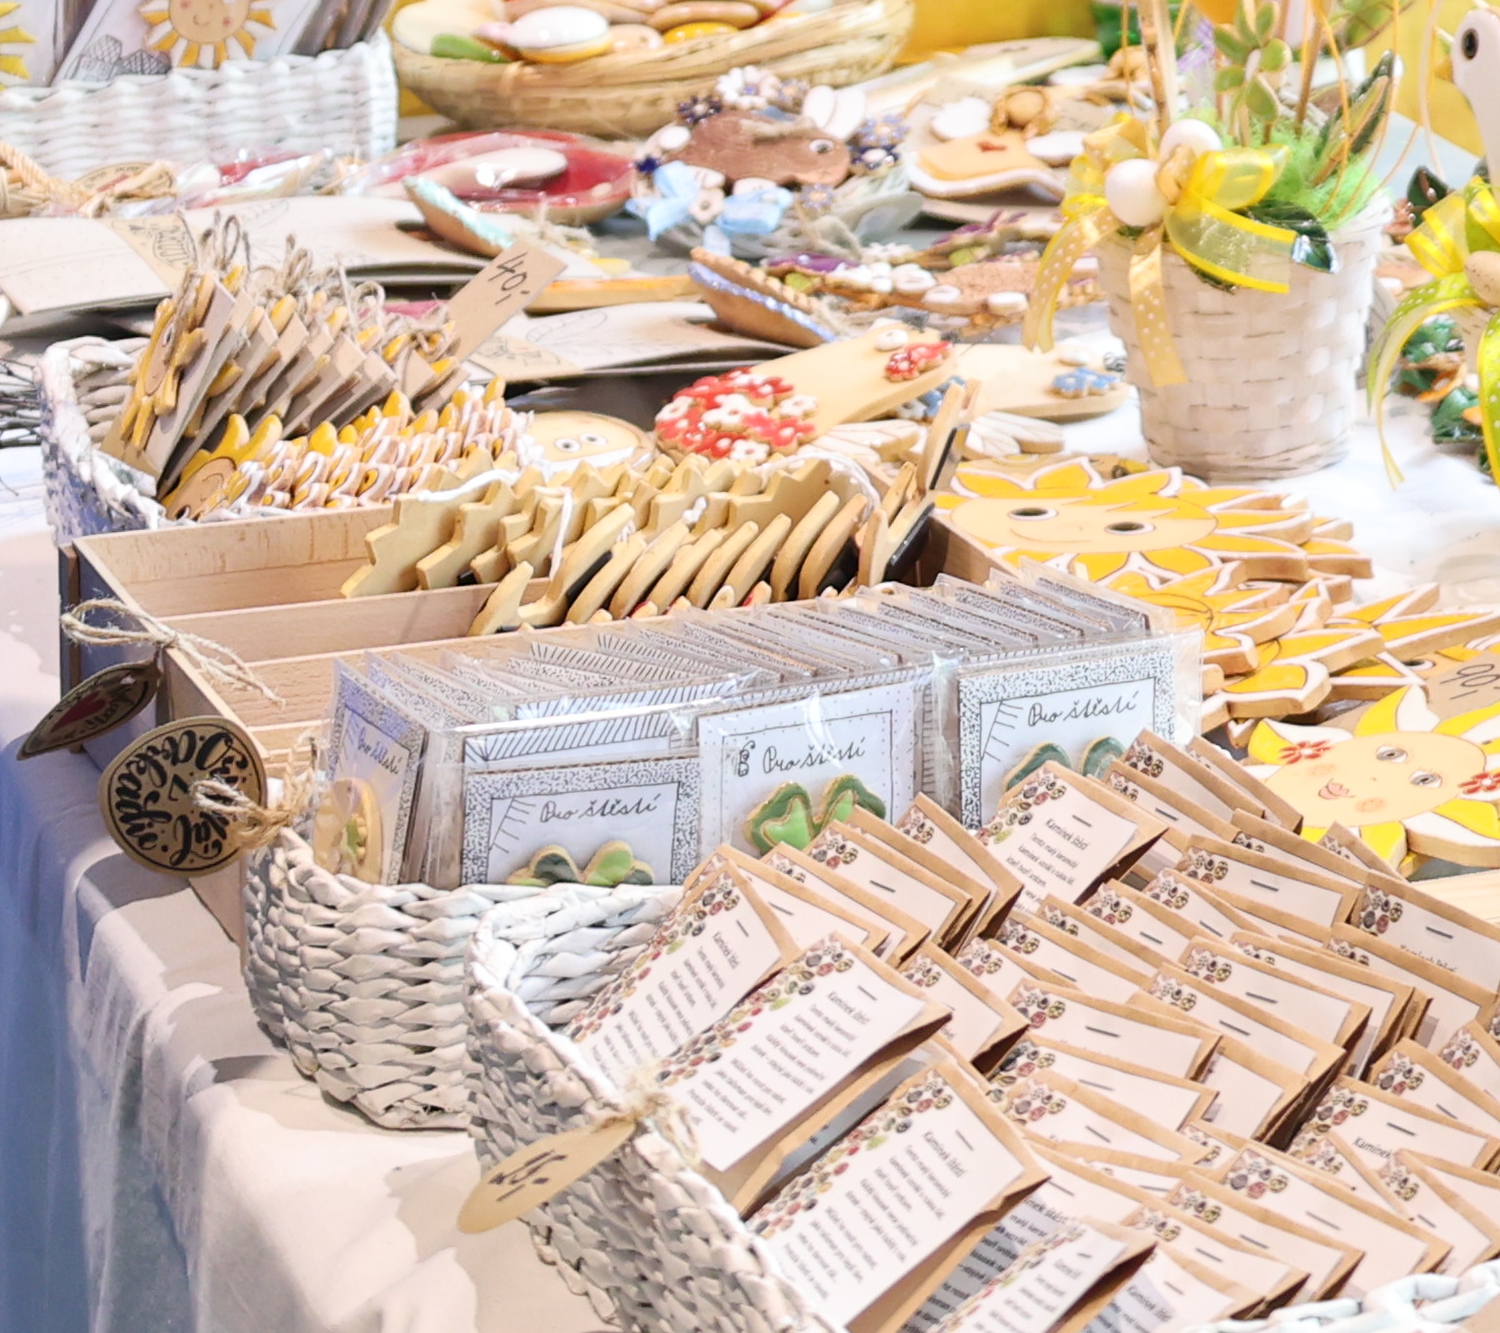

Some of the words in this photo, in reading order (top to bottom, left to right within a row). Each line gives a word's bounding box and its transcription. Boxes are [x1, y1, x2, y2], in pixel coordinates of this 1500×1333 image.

[1027, 701, 1063, 727] Pro
[1062, 690, 1140, 722] štěstí
[762, 744, 804, 775] Pro
[799, 736, 869, 770] štěstí
[538, 799, 578, 824] Pro
[577, 791, 659, 822] štěstí
